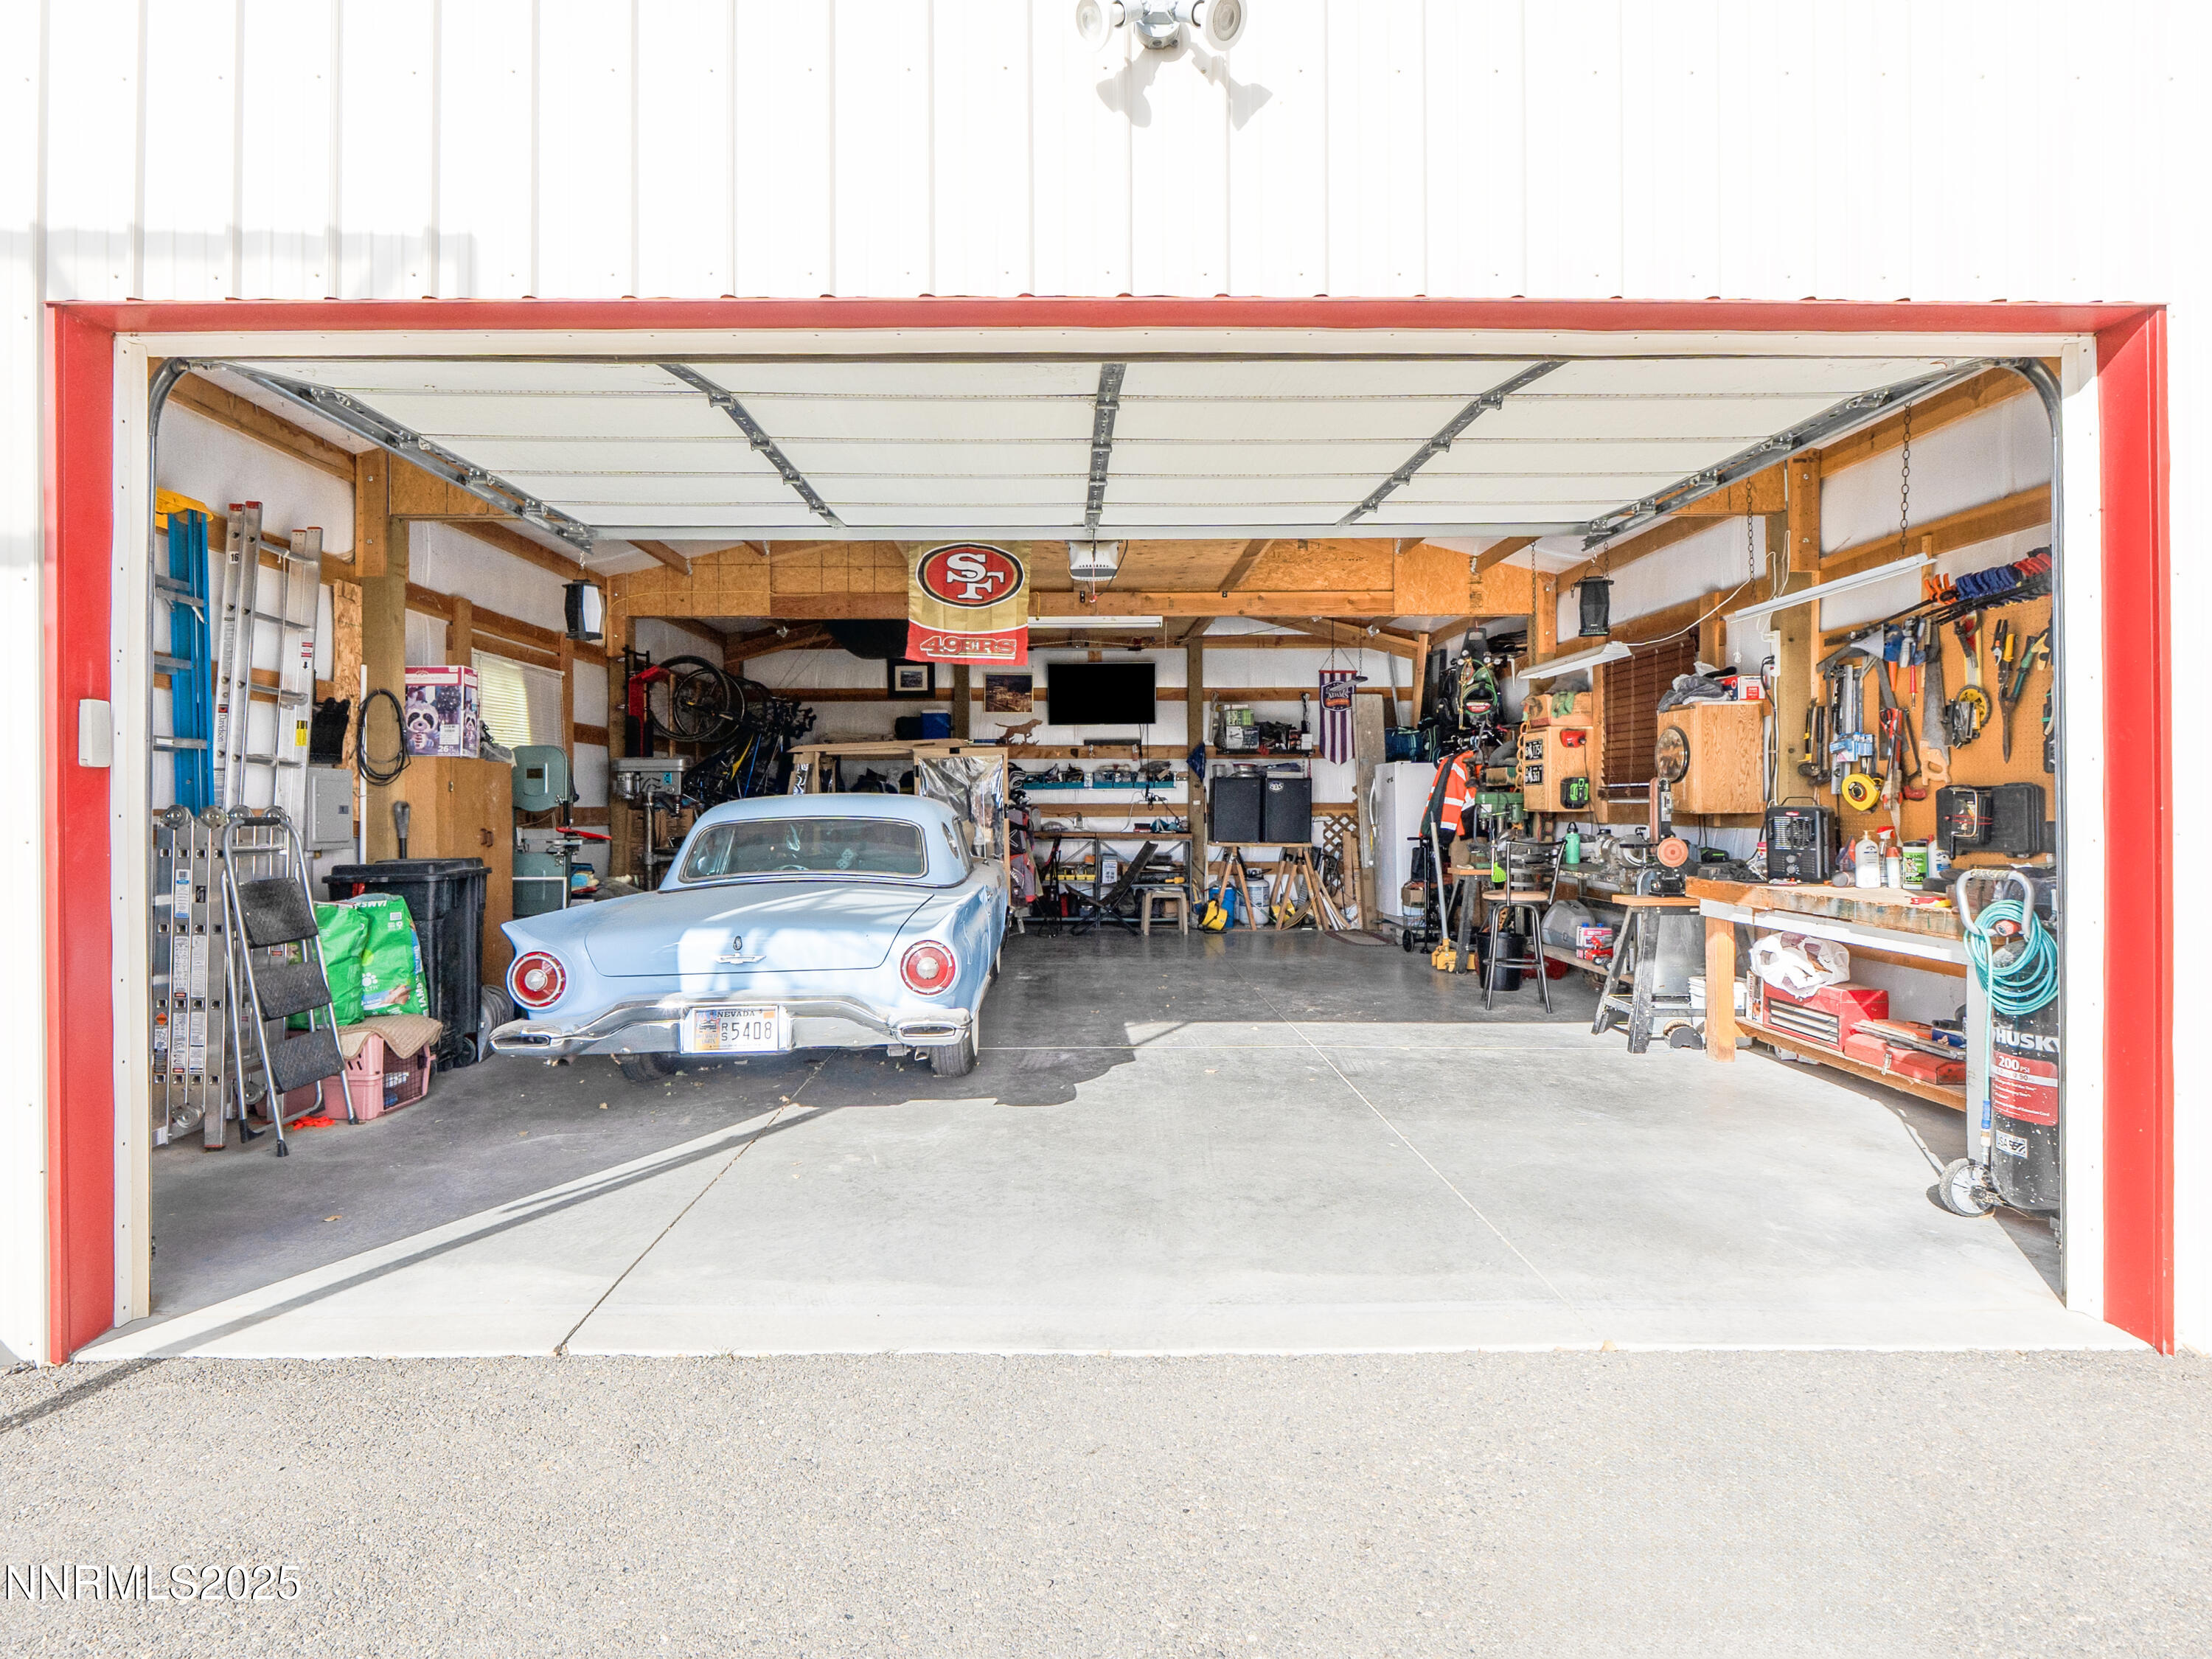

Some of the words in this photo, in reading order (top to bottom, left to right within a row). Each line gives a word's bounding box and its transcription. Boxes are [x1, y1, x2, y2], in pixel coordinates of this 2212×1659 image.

[230, 553, 239, 562] 16
[946, 552, 1004, 599] SF
[920, 636, 1017, 658] 49ERS
[218, 714, 228, 742] Davidson
[721, 1032, 728, 1041] S
[731, 1021, 772, 1040] 5408
[1998, 1055, 2020, 1071] 200
